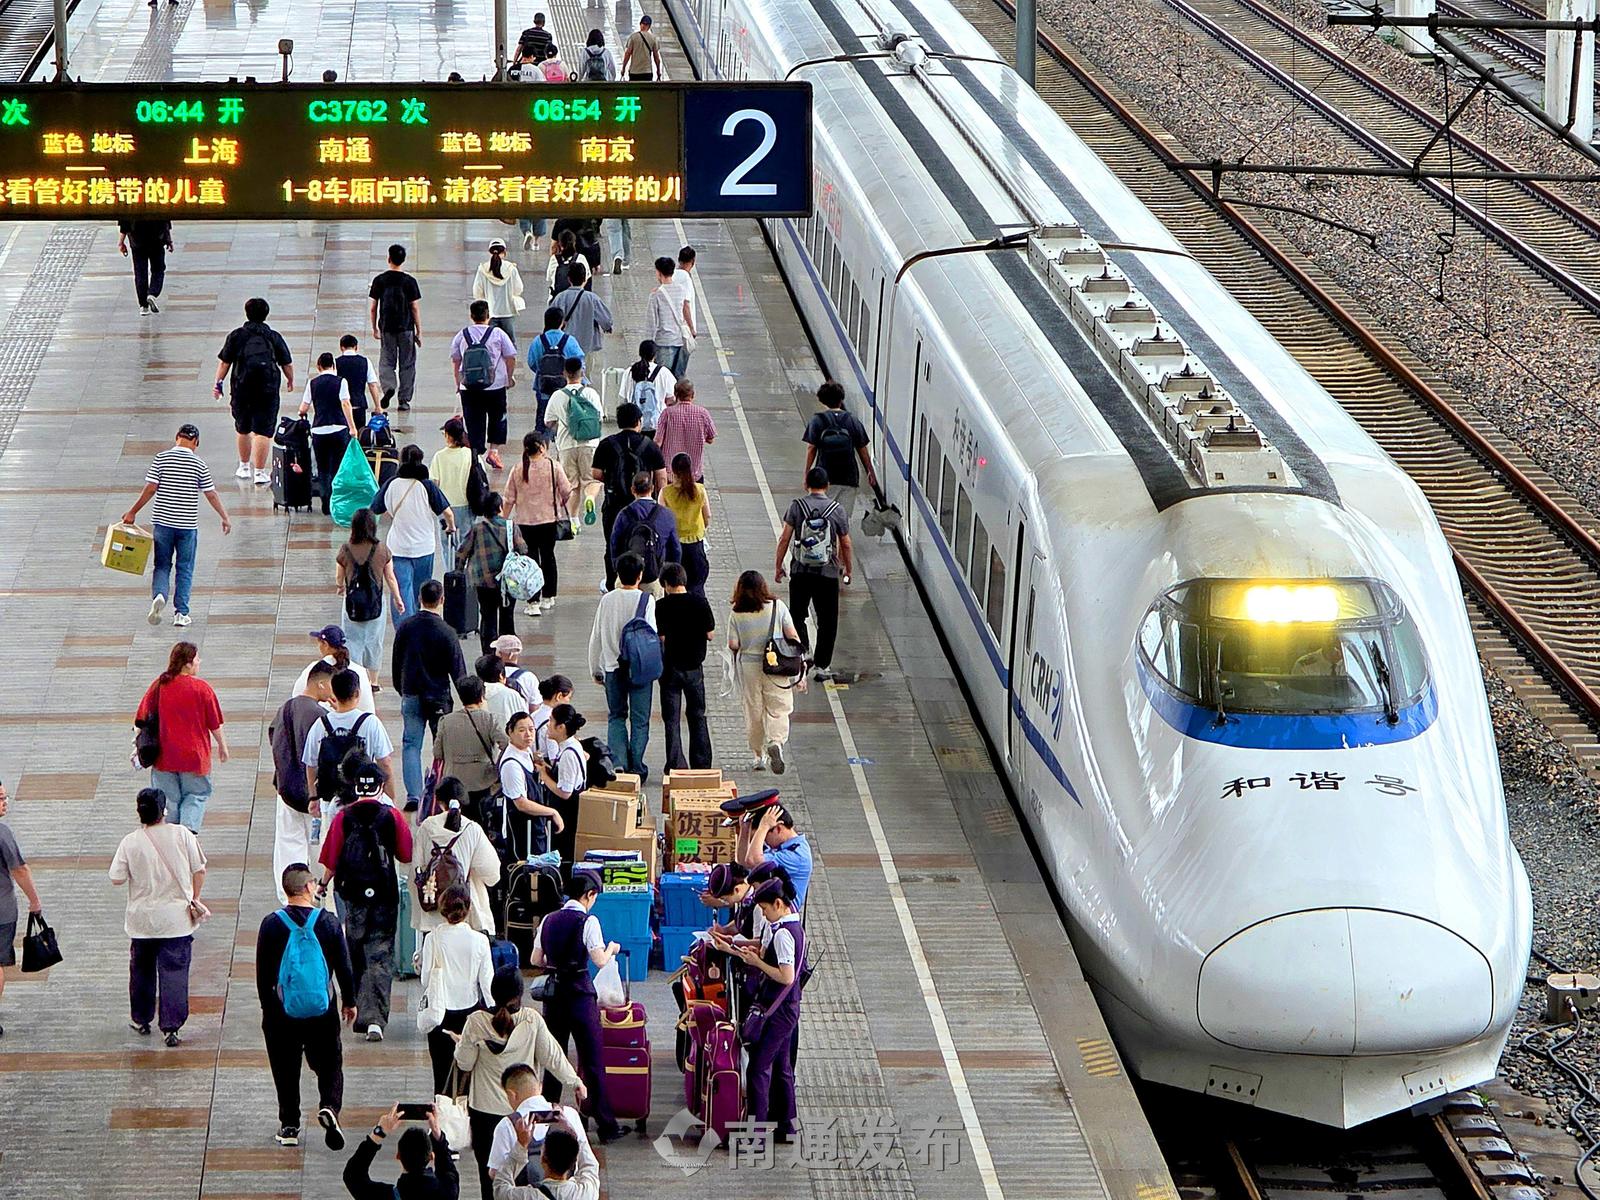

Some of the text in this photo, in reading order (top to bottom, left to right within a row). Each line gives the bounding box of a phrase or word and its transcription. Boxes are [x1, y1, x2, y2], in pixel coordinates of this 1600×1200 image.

[2, 97, 245, 126] 次 06:44 开
[308, 96, 642, 125] C3762 次 06:54 开
[42, 132, 135, 154] 蓝色 地标
[183, 137, 238, 165] 上海
[318, 137, 372, 163] 南通
[440, 131, 532, 153] 蓝色 地标
[580, 135, 635, 163] 南京
[720, 109, 777, 195] 2
[0, 177, 226, 205] 看管好携带的儿童
[1030, 651, 1053, 715] CRH
[1219, 771, 1418, 799] 和谐号
